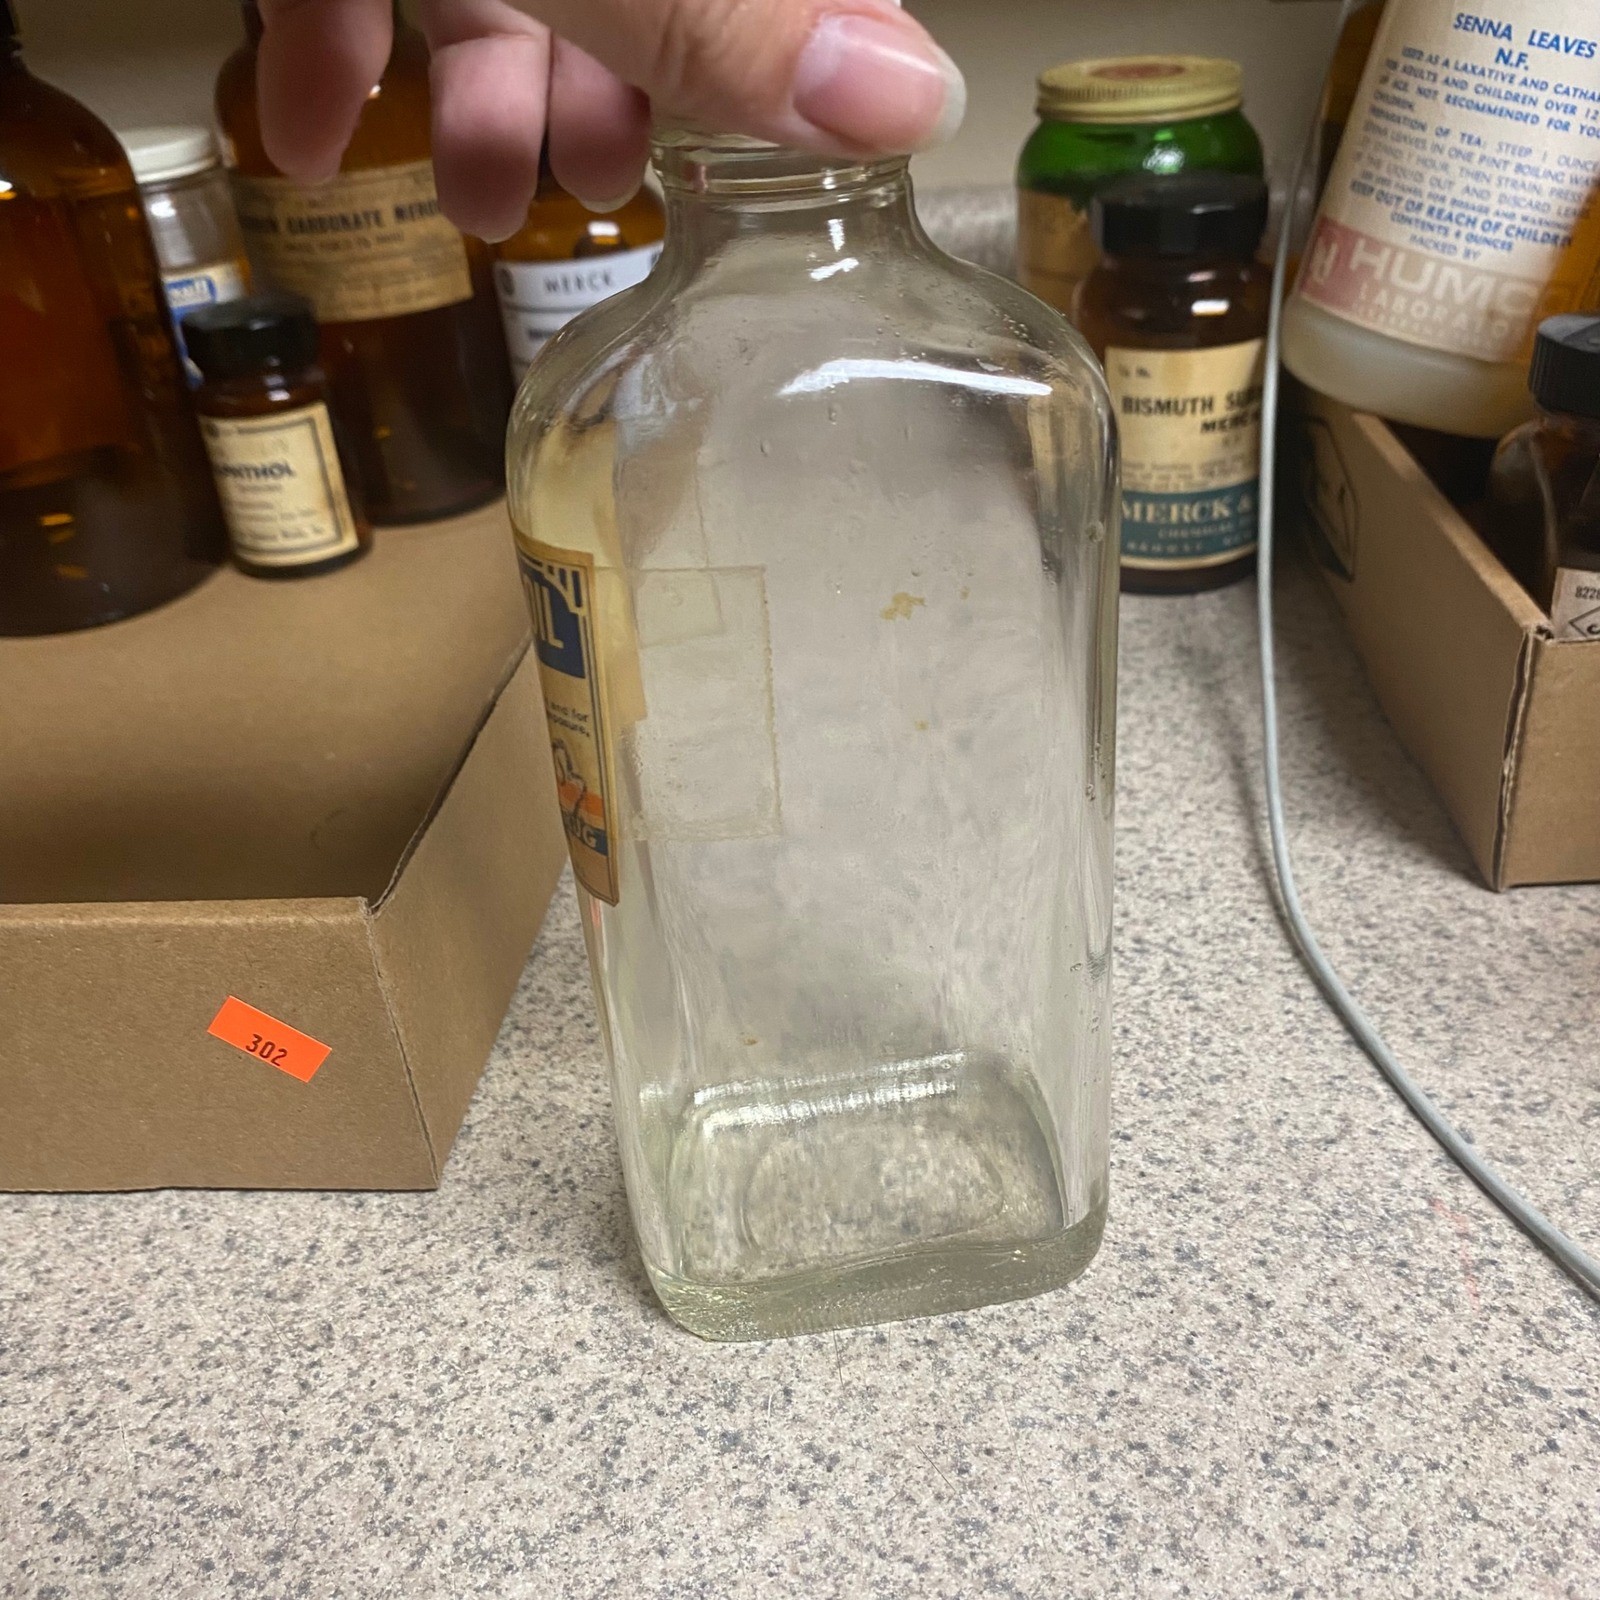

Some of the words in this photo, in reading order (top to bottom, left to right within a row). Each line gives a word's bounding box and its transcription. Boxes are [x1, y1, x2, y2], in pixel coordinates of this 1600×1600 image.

[1453, 12, 1513, 42] SENNA
[1527, 28, 1598, 59] LEAVES
[1453, 59, 1517, 85] LAXATIVE
[1518, 76, 1549, 92] AND
[1494, 46, 1529, 71] N.F.
[1443, 75, 1469, 91] AND
[1473, 82, 1540, 107] CHILDREN
[1544, 99, 1578, 116] OVER
[1444, 93, 1541, 126] RECOMMENDED
[1546, 116, 1571, 132] FOR
[1404, 199, 1424, 213] OF
[1426, 204, 1478, 230] REACH
[1480, 218, 1503, 235] OF
[1122, 396, 1213, 416] BISMUTH
[245, 1033, 288, 1067] 302
